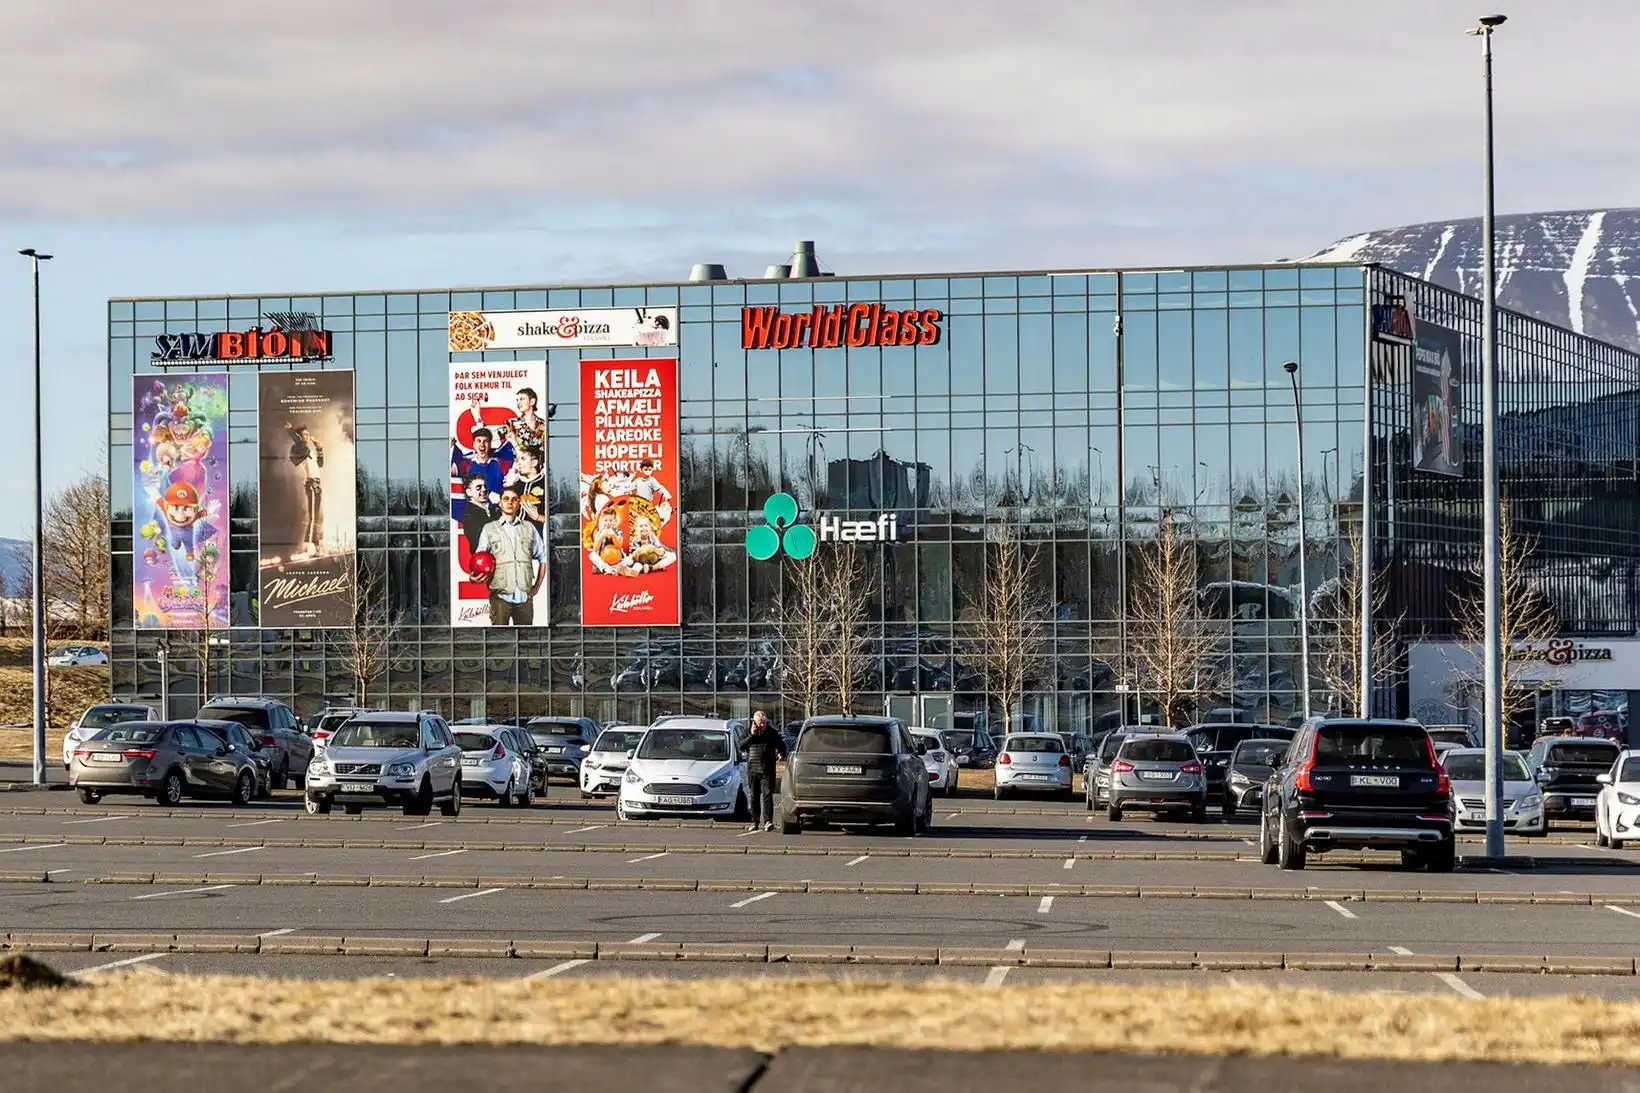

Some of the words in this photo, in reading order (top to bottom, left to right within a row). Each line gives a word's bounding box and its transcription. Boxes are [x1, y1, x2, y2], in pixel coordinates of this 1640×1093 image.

[471, 371, 486, 379] SEM
[488, 370, 528, 378] VENJULEGT
[595, 369, 661, 388] KEILA
[475, 381, 499, 389] KEMUR
[595, 388, 662, 399] SHAKE&PIZZA
[595, 399, 661, 414] AFMÆLI
[595, 428, 662, 442] KAREOKE
[820, 513, 897, 541] Hæfi
[264, 572, 350, 604] Michael
